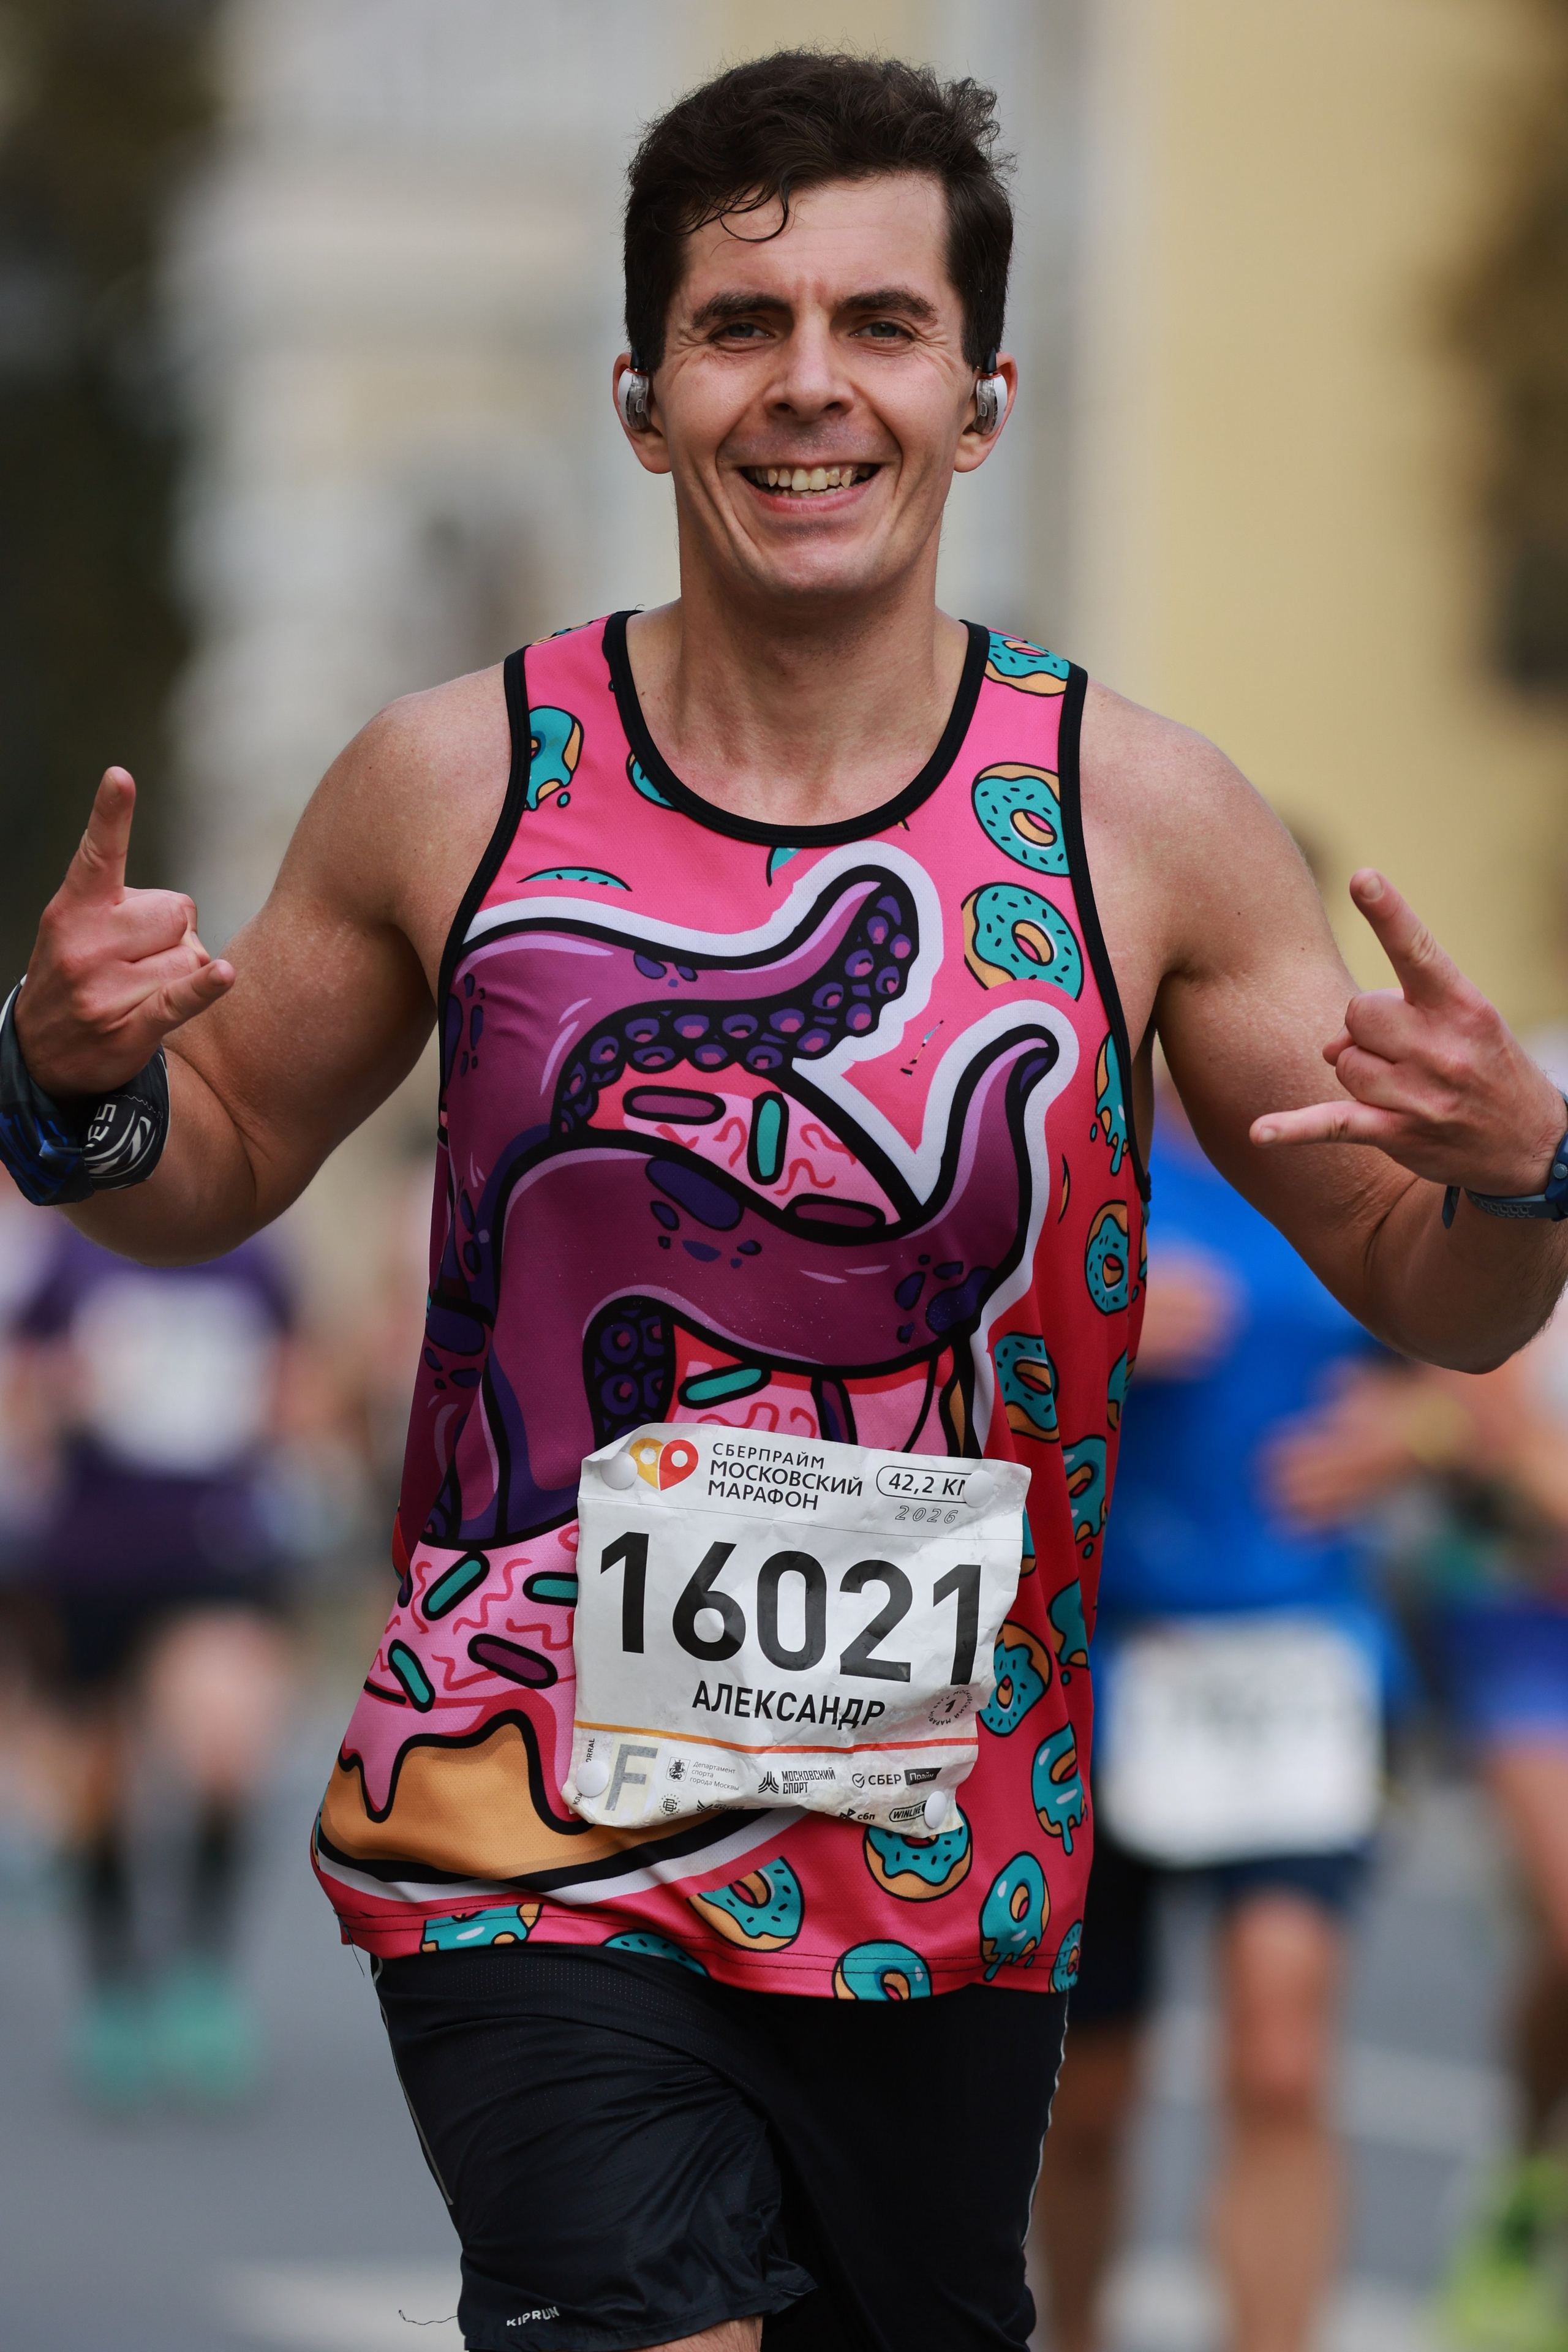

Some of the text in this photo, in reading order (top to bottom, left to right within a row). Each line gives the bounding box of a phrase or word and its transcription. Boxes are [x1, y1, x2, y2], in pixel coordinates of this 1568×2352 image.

[712, 1442, 824, 1469] СБЕРПРАЙМ
[710, 1460, 863, 1496] МОСКОВСКИЙ
[888, 1472, 935, 1495] 42,2
[708, 1480, 819, 1510] МАРАФОН
[895, 1505, 959, 1524] 2026
[600, 1531, 981, 1686] 16021
[692, 1680, 886, 1730] АЛЕКСАНДР
[944, 1699, 957, 1713] 1
[586, 1738, 595, 1763] ORRAL
[604, 1743, 658, 1811] F
[692, 1770, 714, 1778] спорта
[693, 1761, 736, 1774] Департамент
[781, 1766, 836, 1782] МОСКОВСКИЙ
[690, 1777, 739, 1791] города Москвы
[783, 1782, 809, 1794] СПОРТ
[868, 1771, 935, 1785] СБЕР Прайм
[893, 1805, 922, 1819] WINLINE
[506, 2306, 560, 2327] KIPRUN
